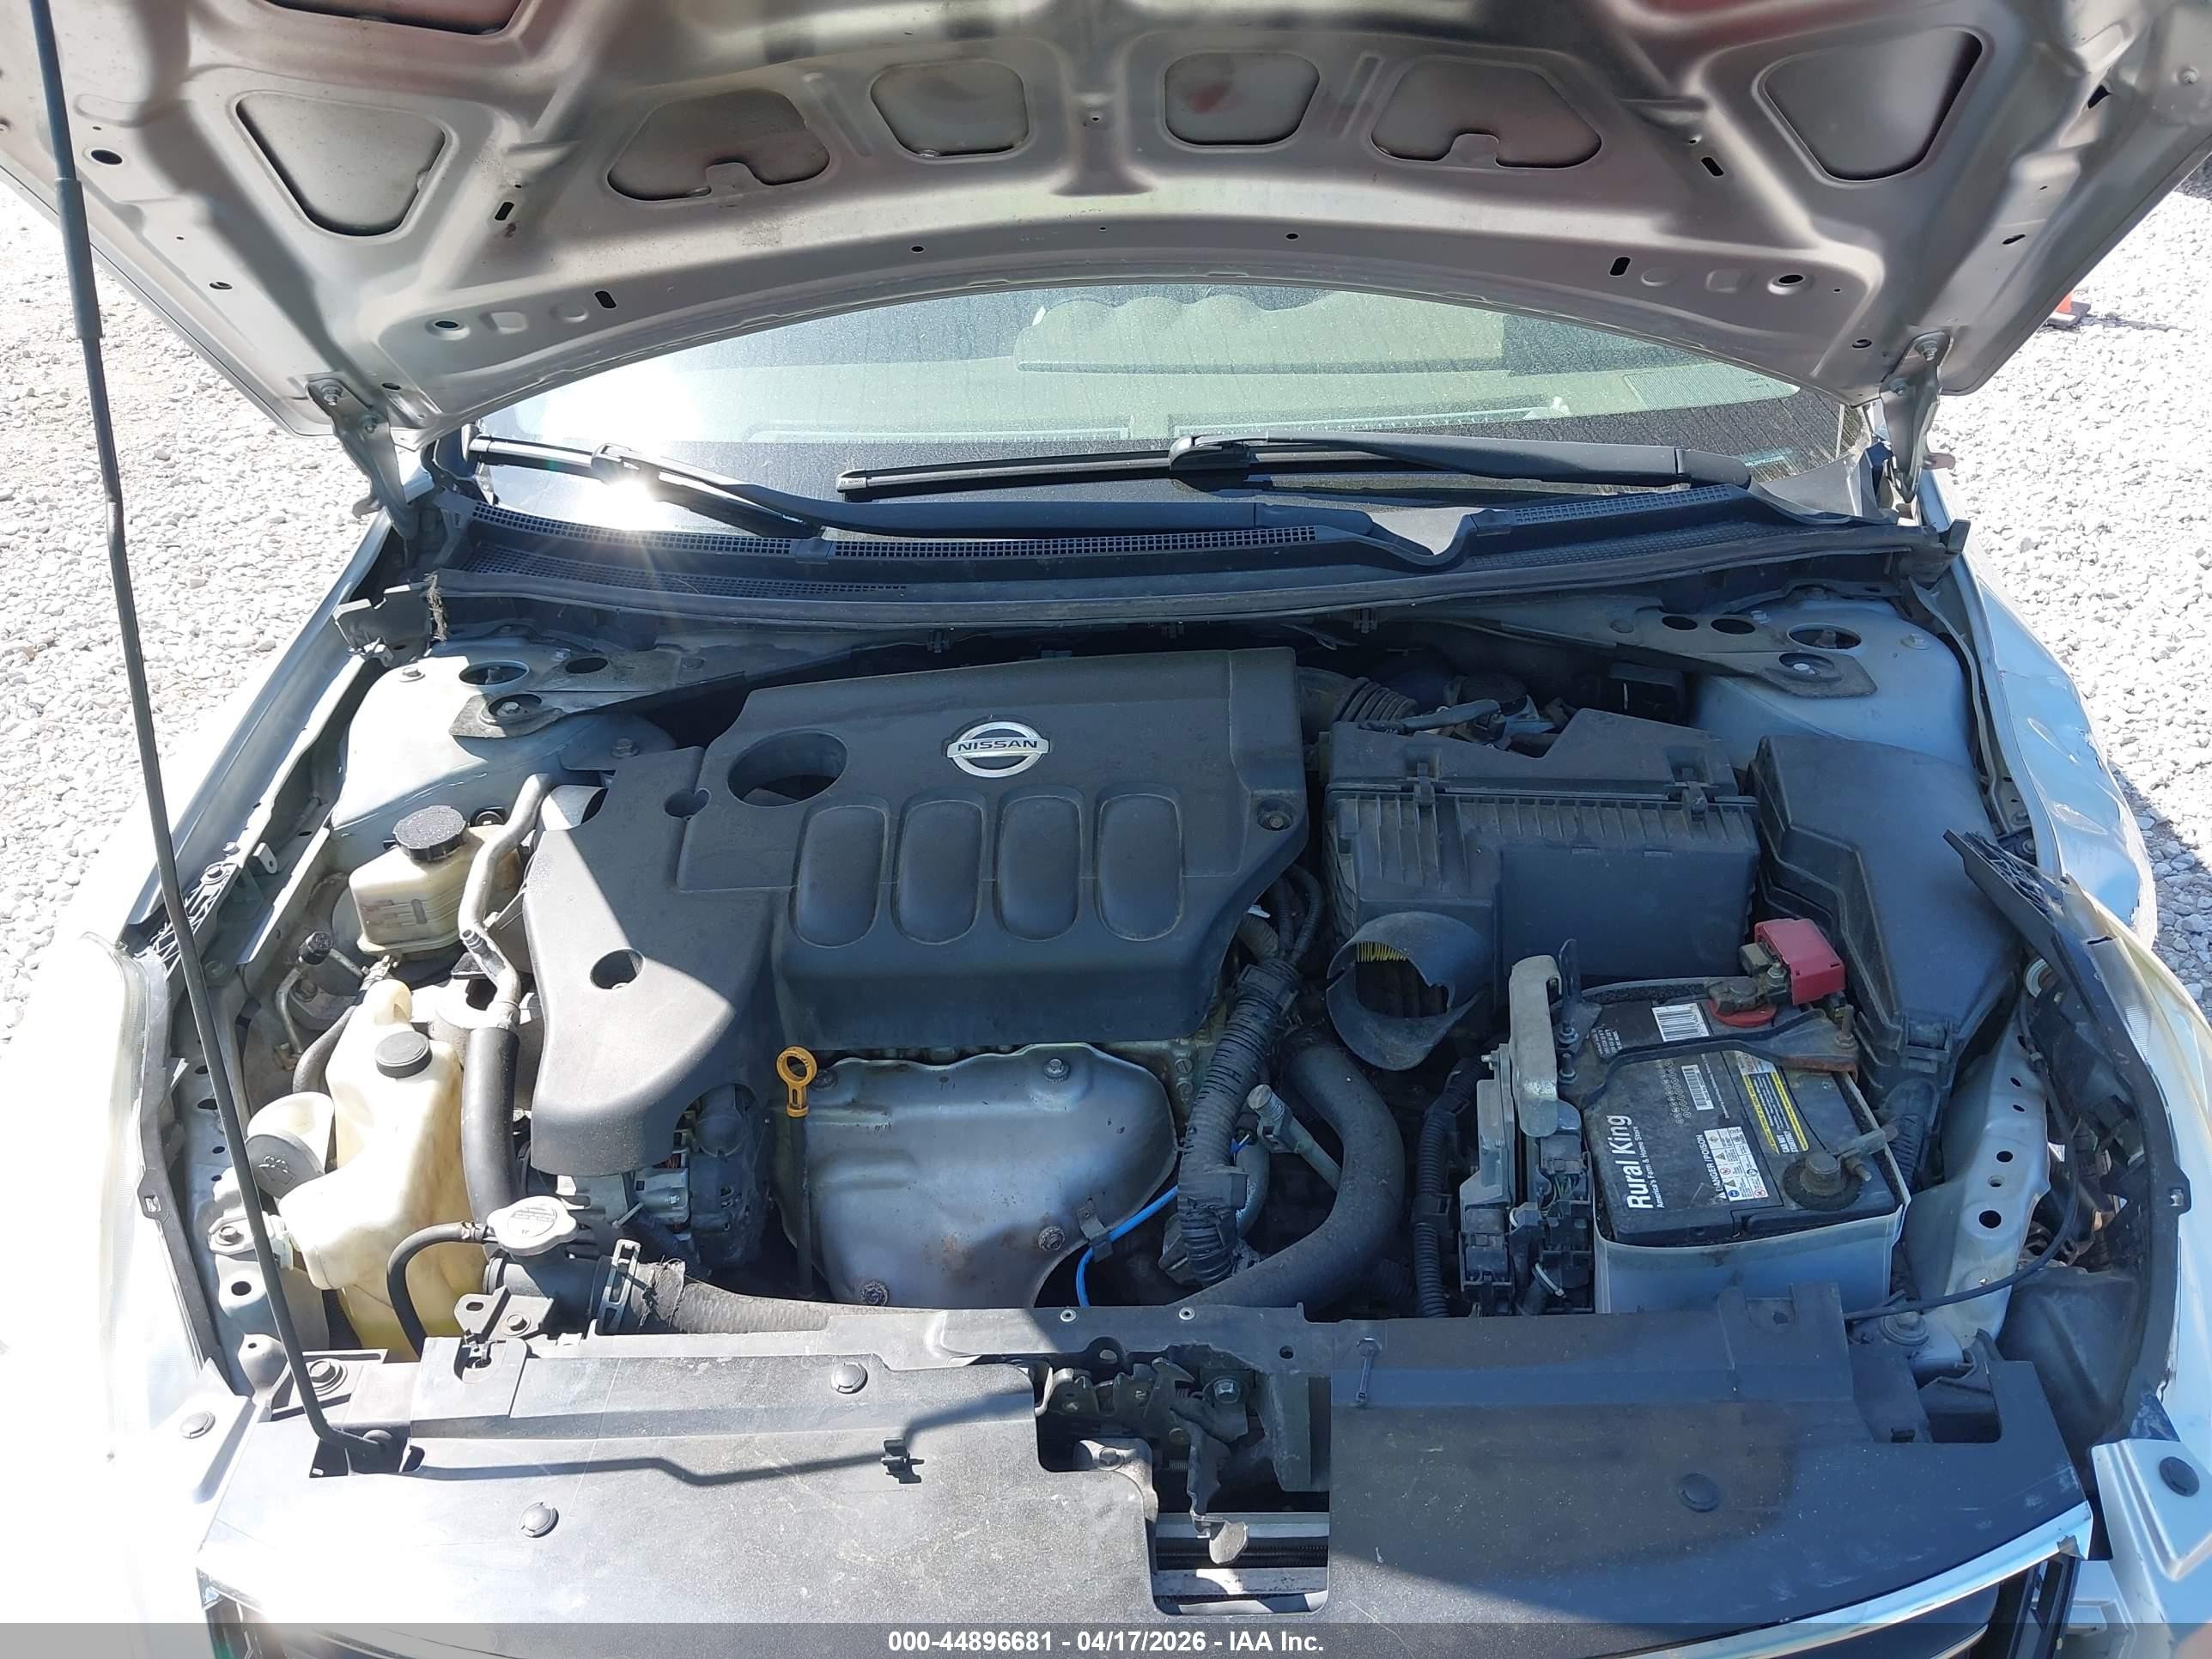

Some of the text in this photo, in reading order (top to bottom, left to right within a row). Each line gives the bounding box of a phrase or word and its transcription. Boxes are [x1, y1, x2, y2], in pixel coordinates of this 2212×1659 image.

[957, 740, 1037, 751] NISSAN
[1632, 1126, 1643, 1140] Store
[1638, 1142, 1648, 1158] Home
[1606, 1115, 1653, 1208] Rural King
[1645, 1164, 1655, 1179] Farm
[1706, 1163, 1723, 1192] DANGER
[1650, 1179, 1665, 1208] America's
